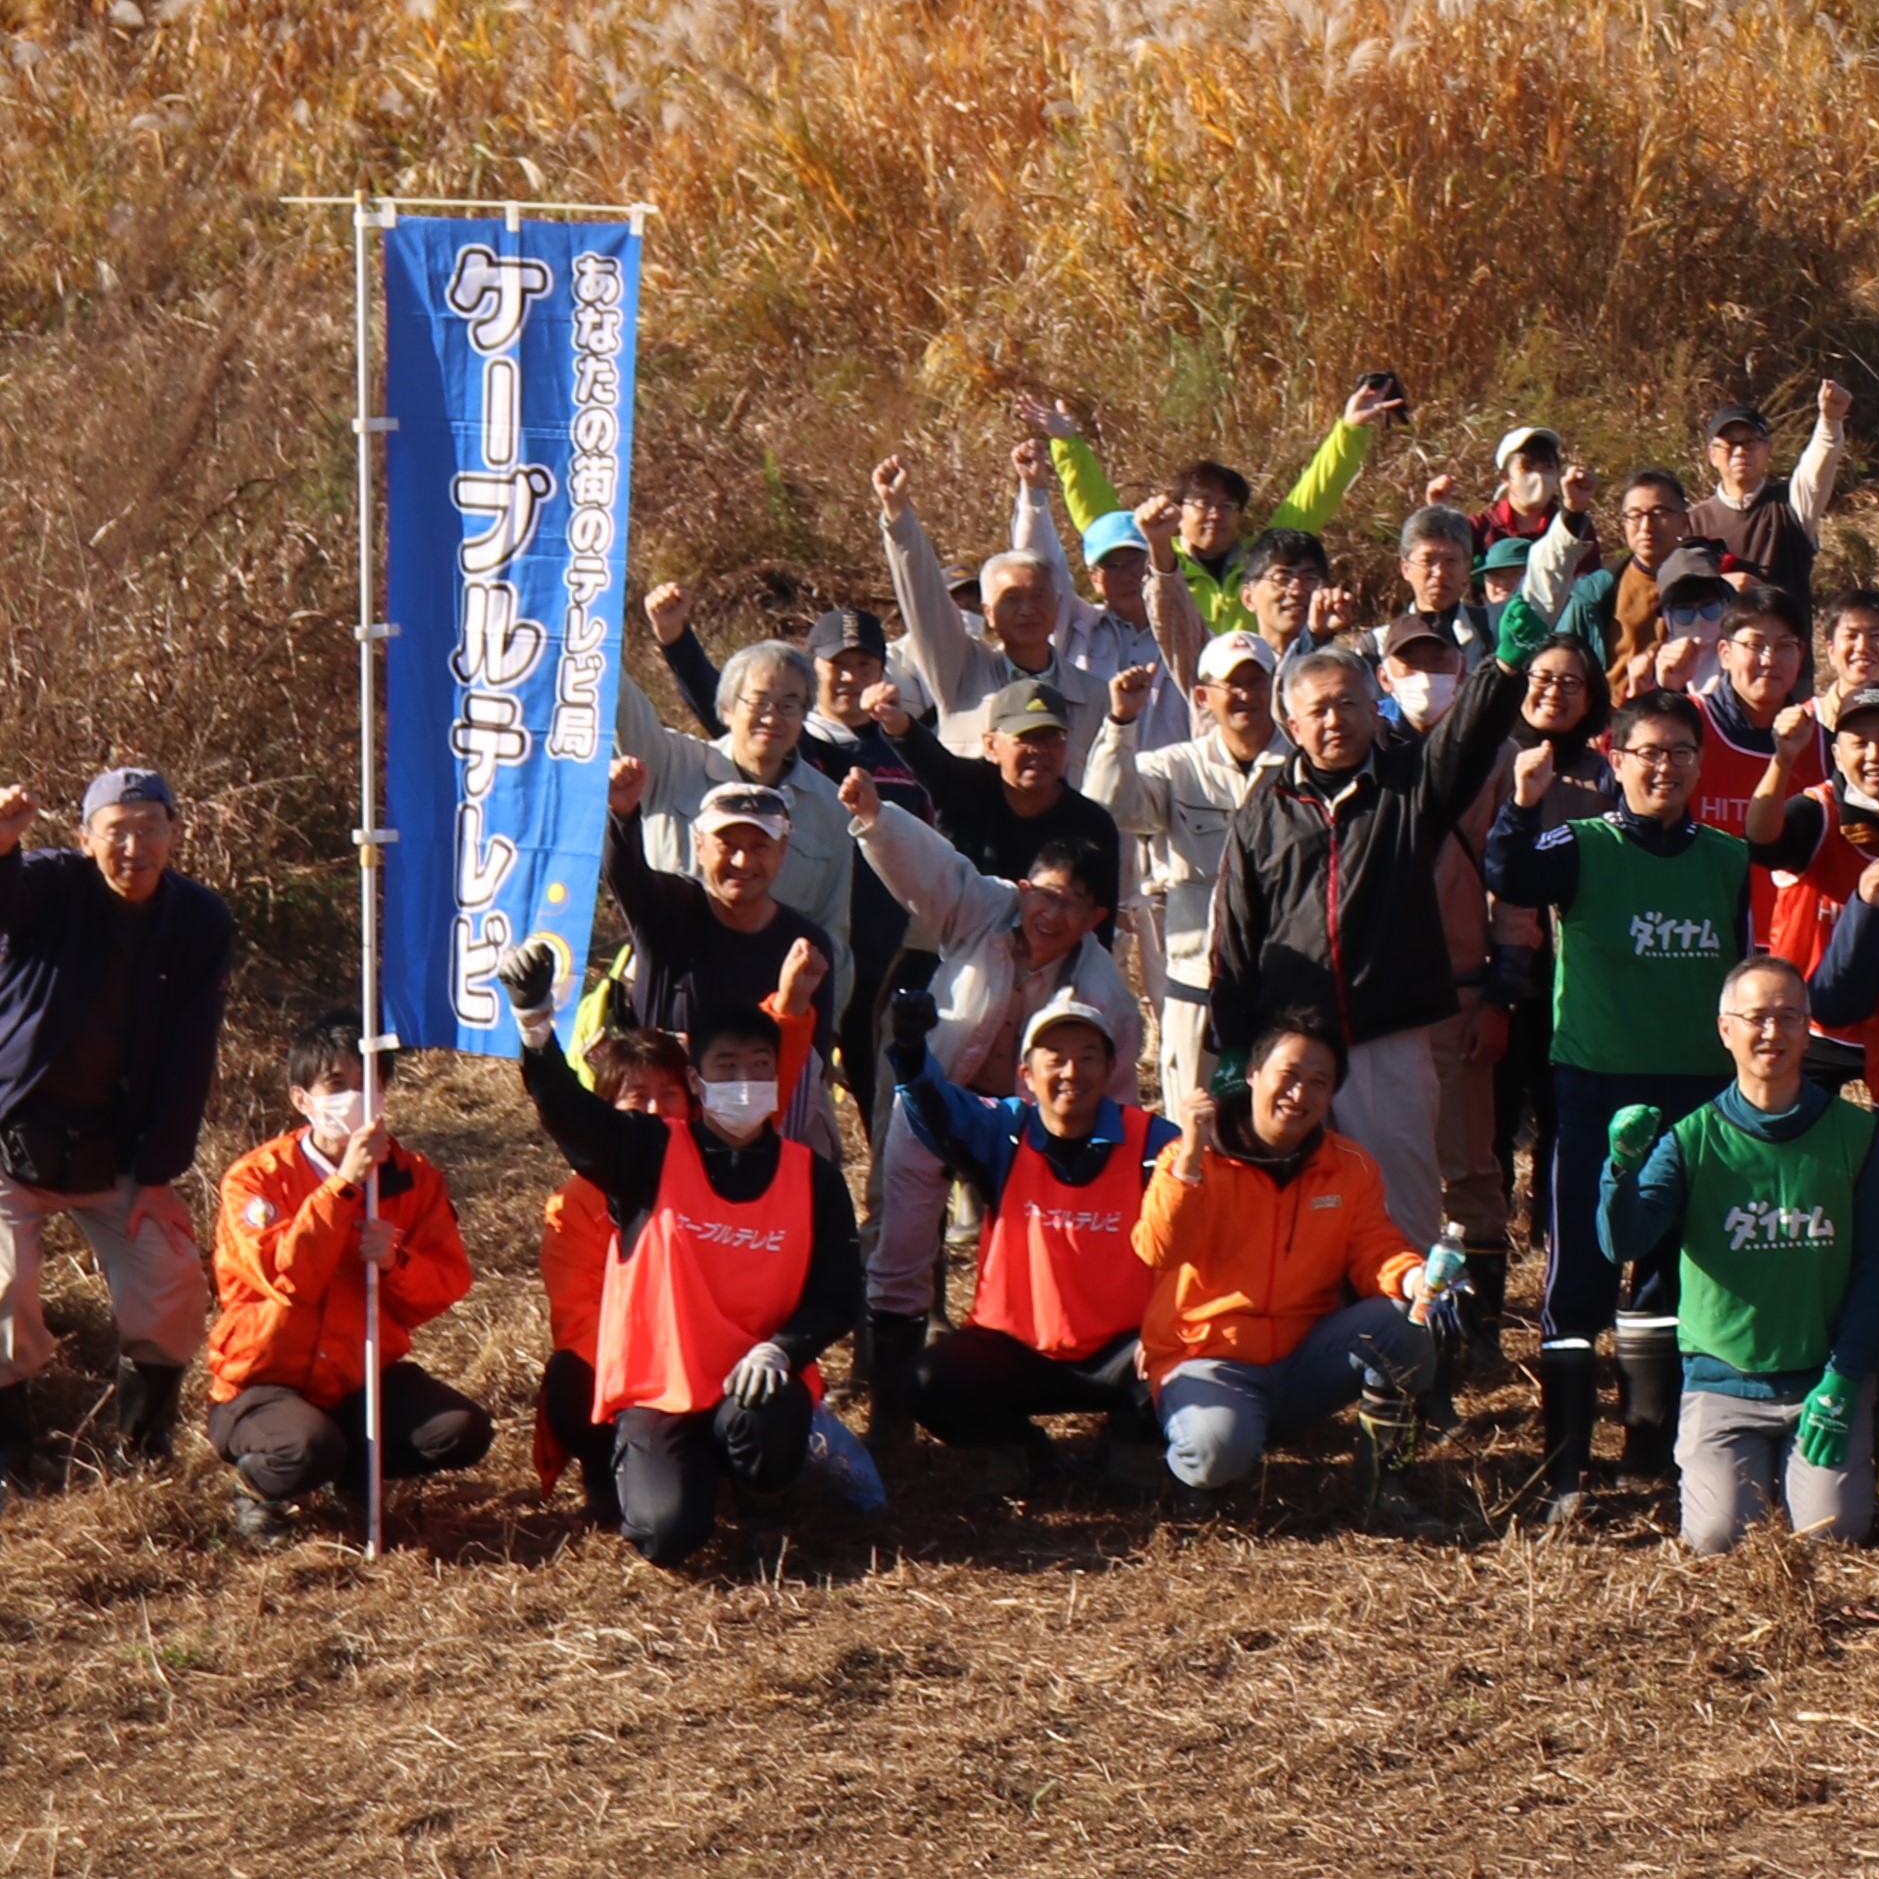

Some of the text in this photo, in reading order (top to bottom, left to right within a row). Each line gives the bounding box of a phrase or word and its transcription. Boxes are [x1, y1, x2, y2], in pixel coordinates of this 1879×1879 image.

[446, 243, 555, 1031] ケーブルテレビ
[546, 251, 623, 763] あなたの街のテレビ局
[1630, 911, 1720, 954] ダイナム
[1724, 1201, 1834, 1251] ダイナム
